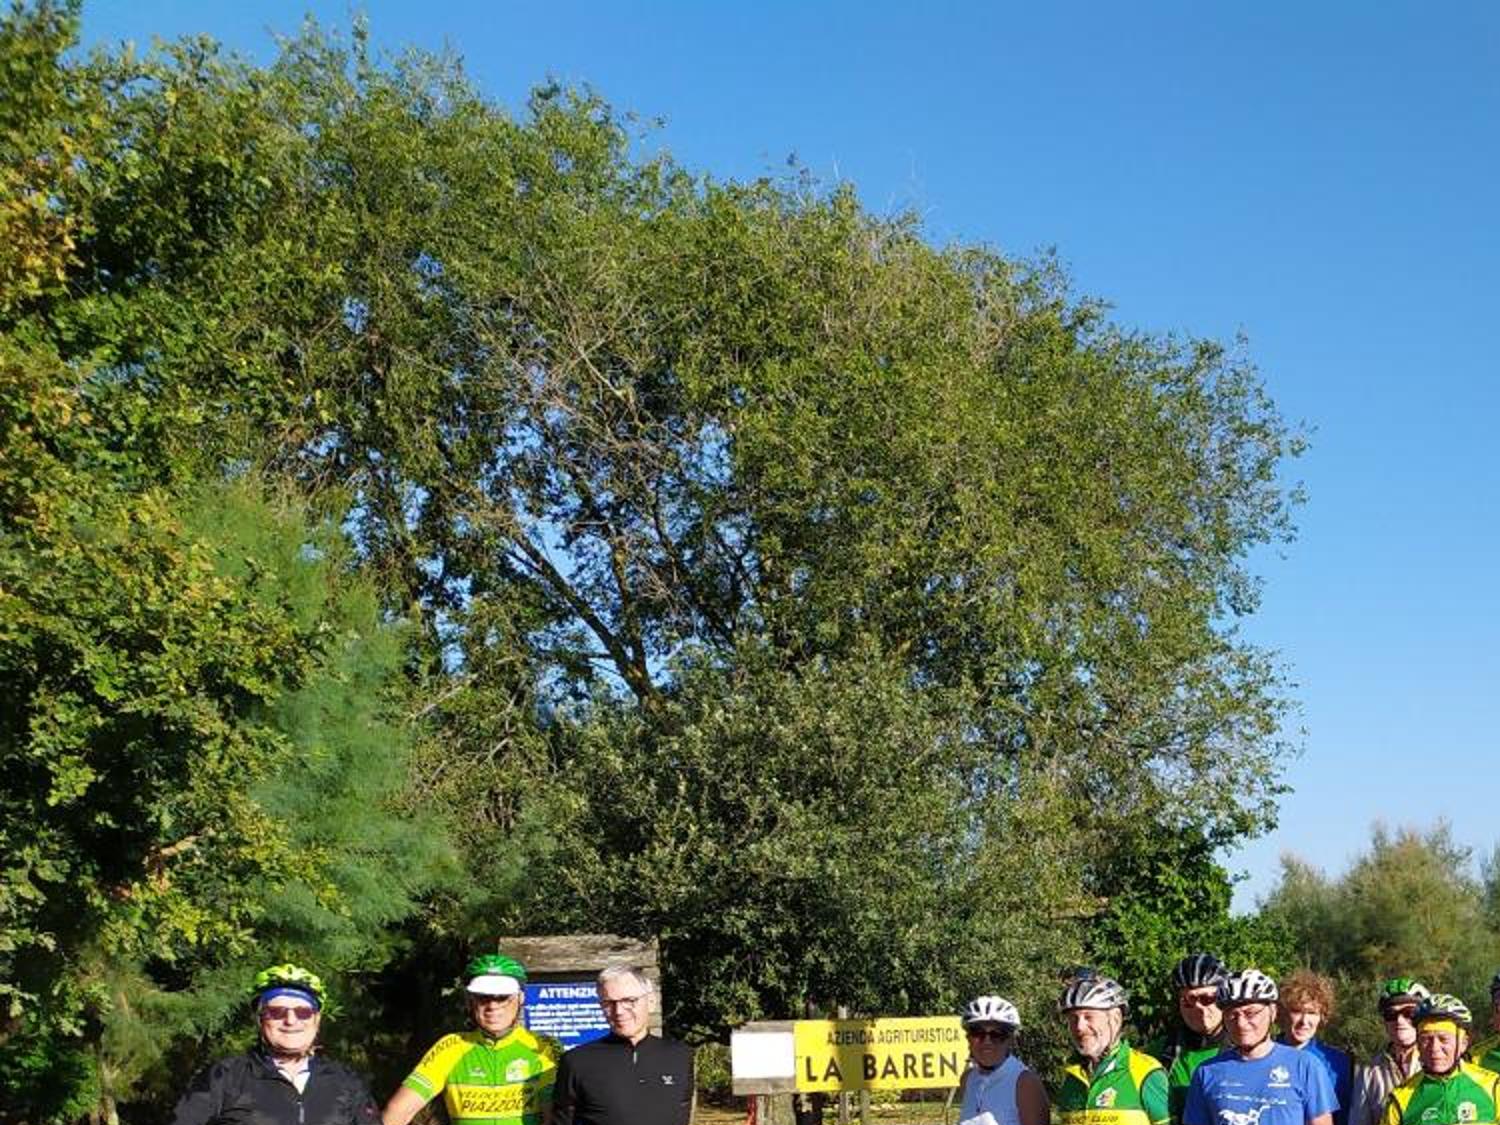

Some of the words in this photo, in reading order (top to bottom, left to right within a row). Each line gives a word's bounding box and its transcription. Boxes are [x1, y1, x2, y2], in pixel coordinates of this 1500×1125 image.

[827, 1030, 874, 1045] AZIENDA
[878, 1027, 960, 1044] AGRITURISTICA
[863, 1052, 961, 1081] BAREN
